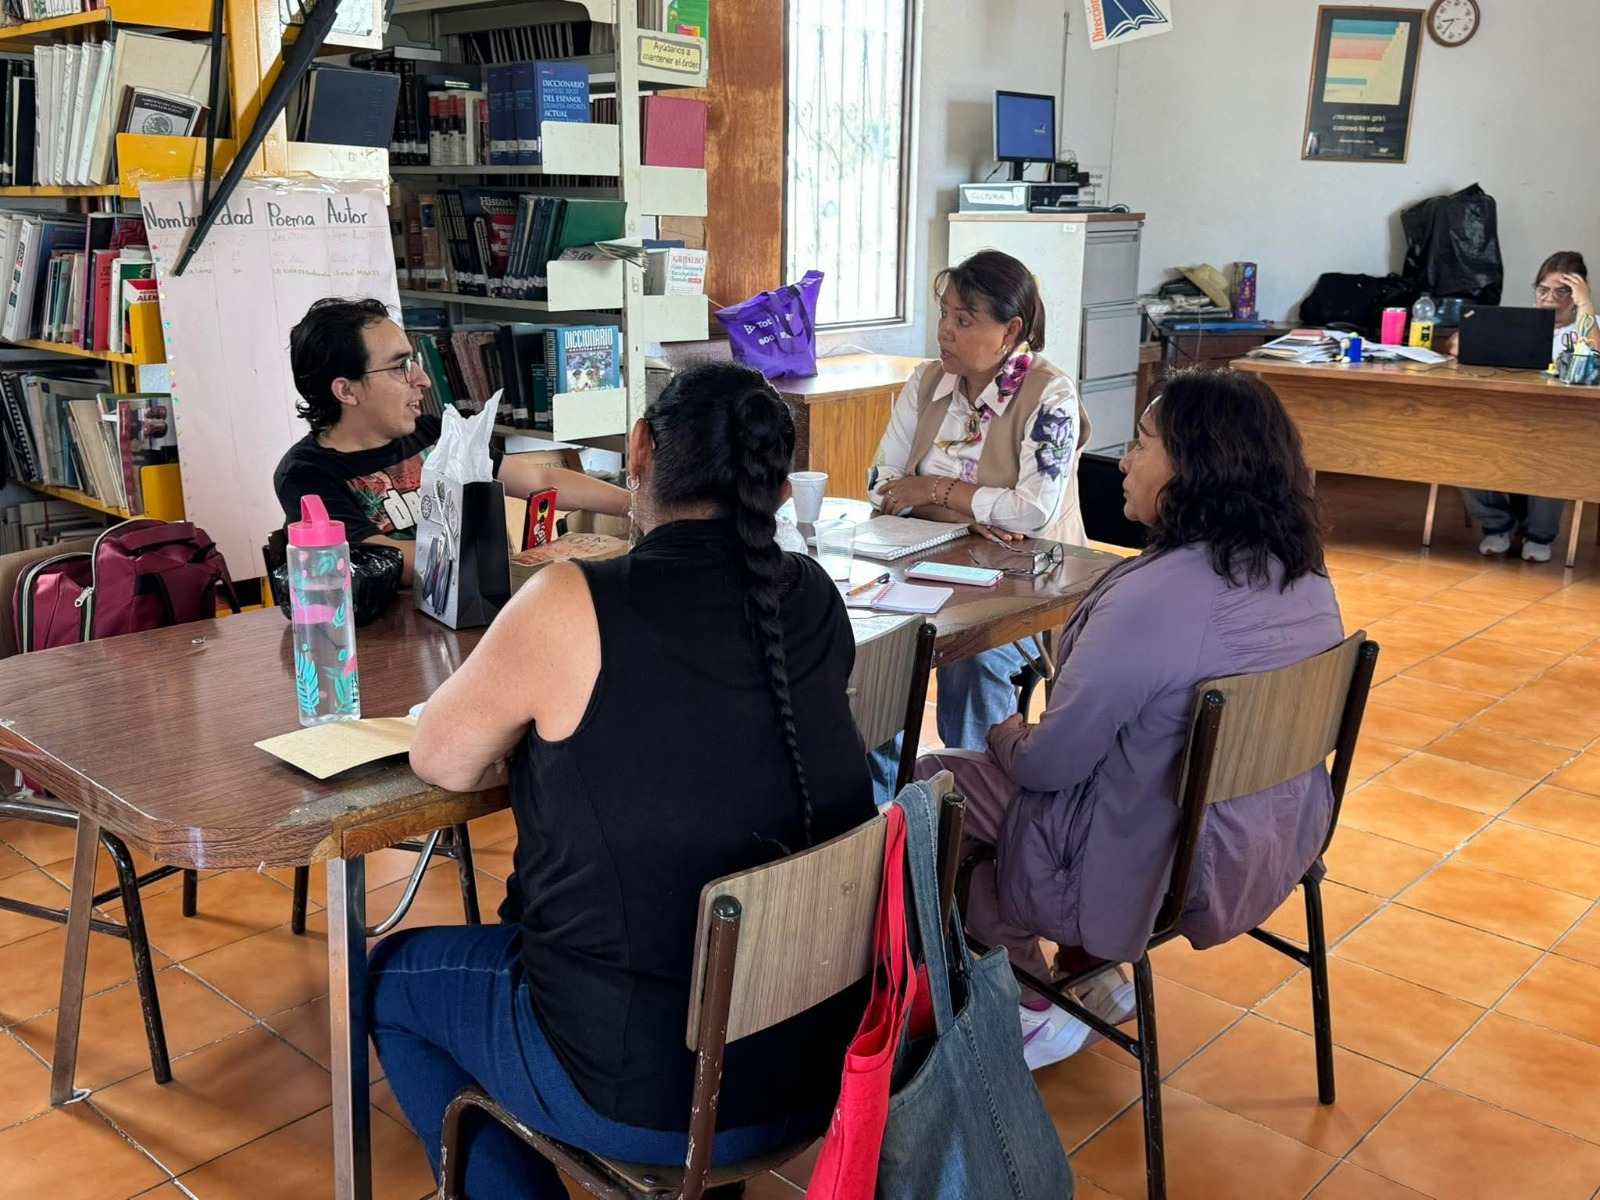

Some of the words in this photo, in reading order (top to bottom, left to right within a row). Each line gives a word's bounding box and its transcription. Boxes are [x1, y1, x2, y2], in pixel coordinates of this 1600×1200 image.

[643, 53, 674, 65] mantener
[542, 79, 585, 89] DICCIONARIO
[543, 94, 555, 102] DEL
[555, 94, 582, 104] ESPAÑOL
[543, 109, 568, 118] ACTUAL
[266, 201, 316, 227] Poema
[326, 196, 368, 225] Autor
[564, 328, 613, 349] DICCIONARIO
